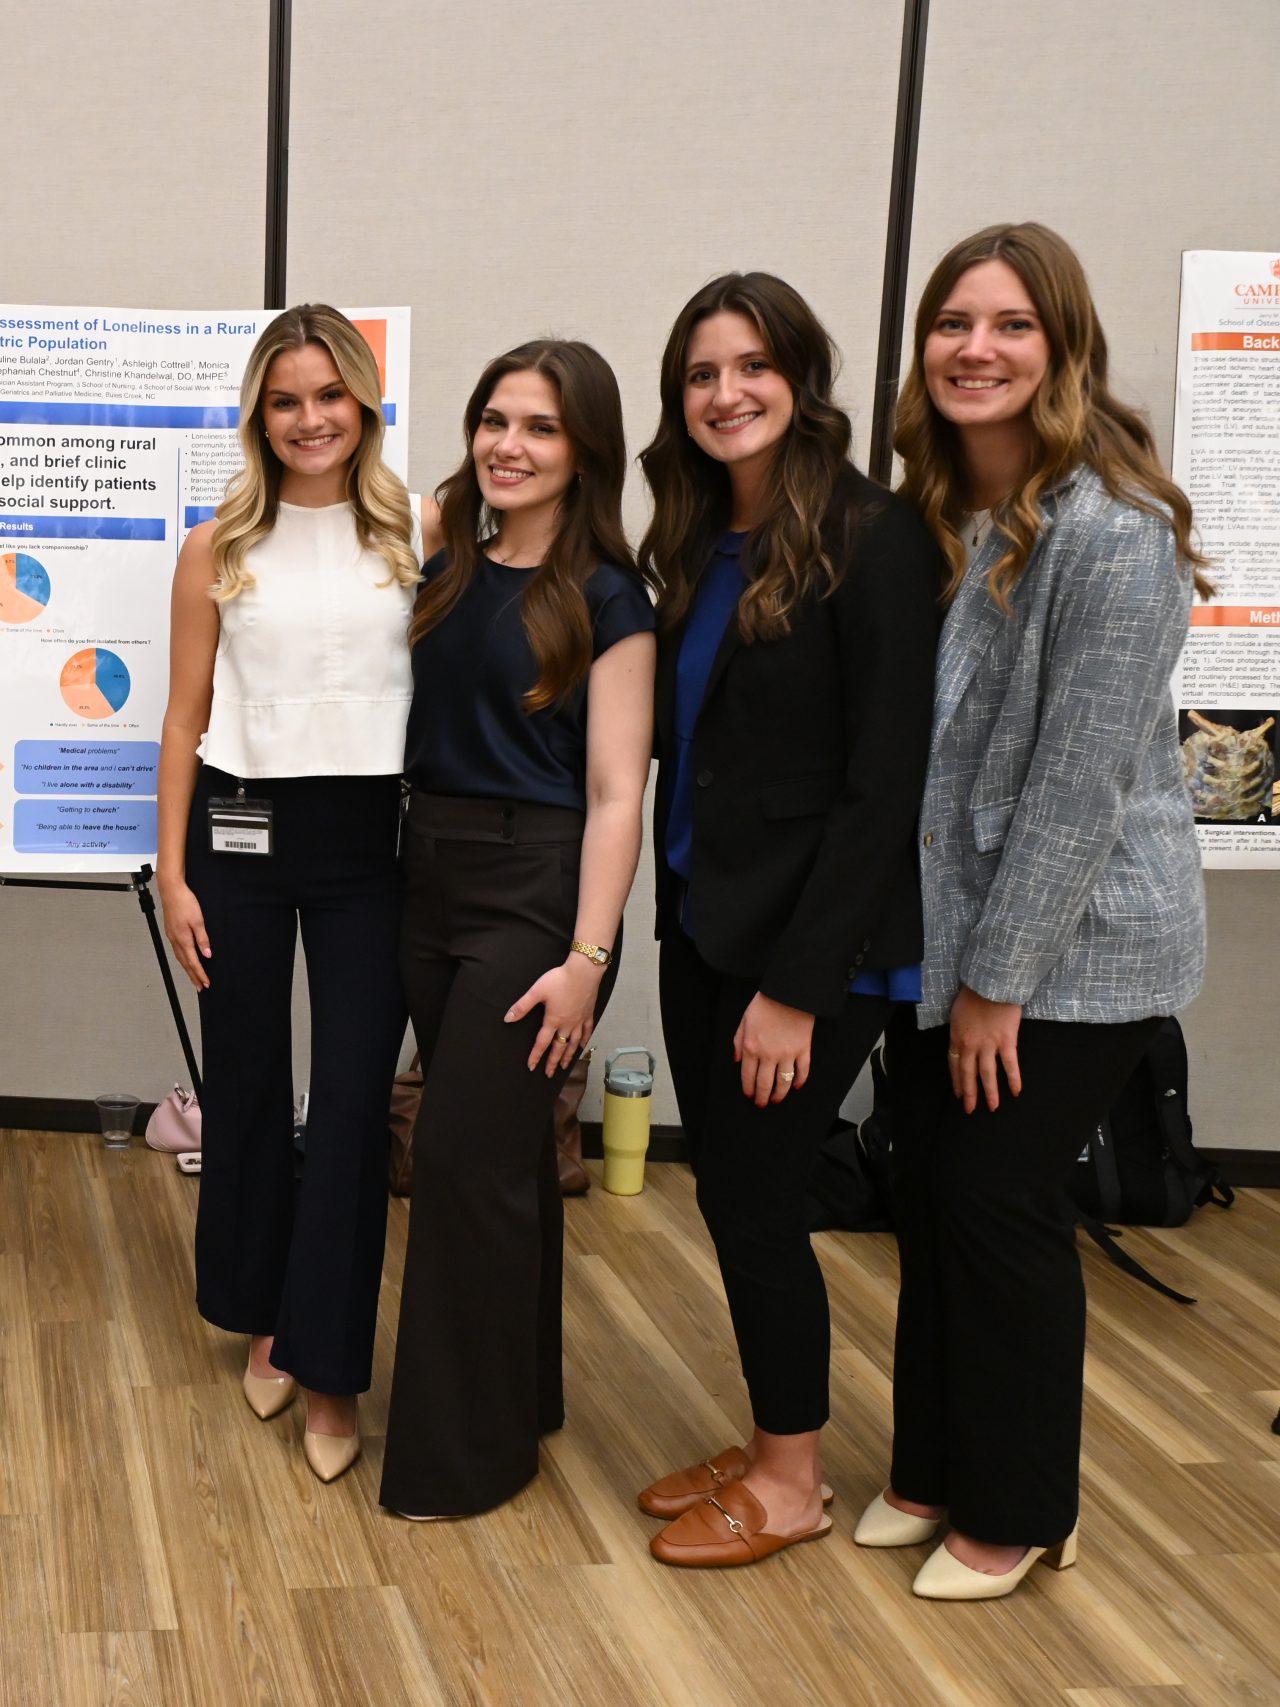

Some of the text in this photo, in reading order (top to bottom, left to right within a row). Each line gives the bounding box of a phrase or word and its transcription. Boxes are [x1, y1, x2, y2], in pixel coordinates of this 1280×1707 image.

[84, 319, 98, 331] of
[103, 320, 181, 335] Loneliness
[186, 322, 199, 334] in
[204, 325, 212, 335] a
[217, 322, 256, 335] Rural
[28, 336, 108, 351] Population
[55, 357, 84, 366] Jordan
[122, 359, 158, 370] Ashleigh
[198, 360, 229, 370] Monica
[85, 369, 121, 379] Christine
[124, 370, 175, 381] Khandelwal,
[178, 372, 194, 382] DO,
[60, 437, 115, 452] among
[120, 437, 156, 451] rural
[9, 454, 39, 468] and
[44, 455, 80, 469] brief
[85, 456, 127, 470] clinic
[30, 475, 89, 492] identify
[93, 477, 157, 493] patients
[49, 497, 116, 512] support.
[0, 521, 34, 531] Results
[1257, 813, 1266, 823] A
